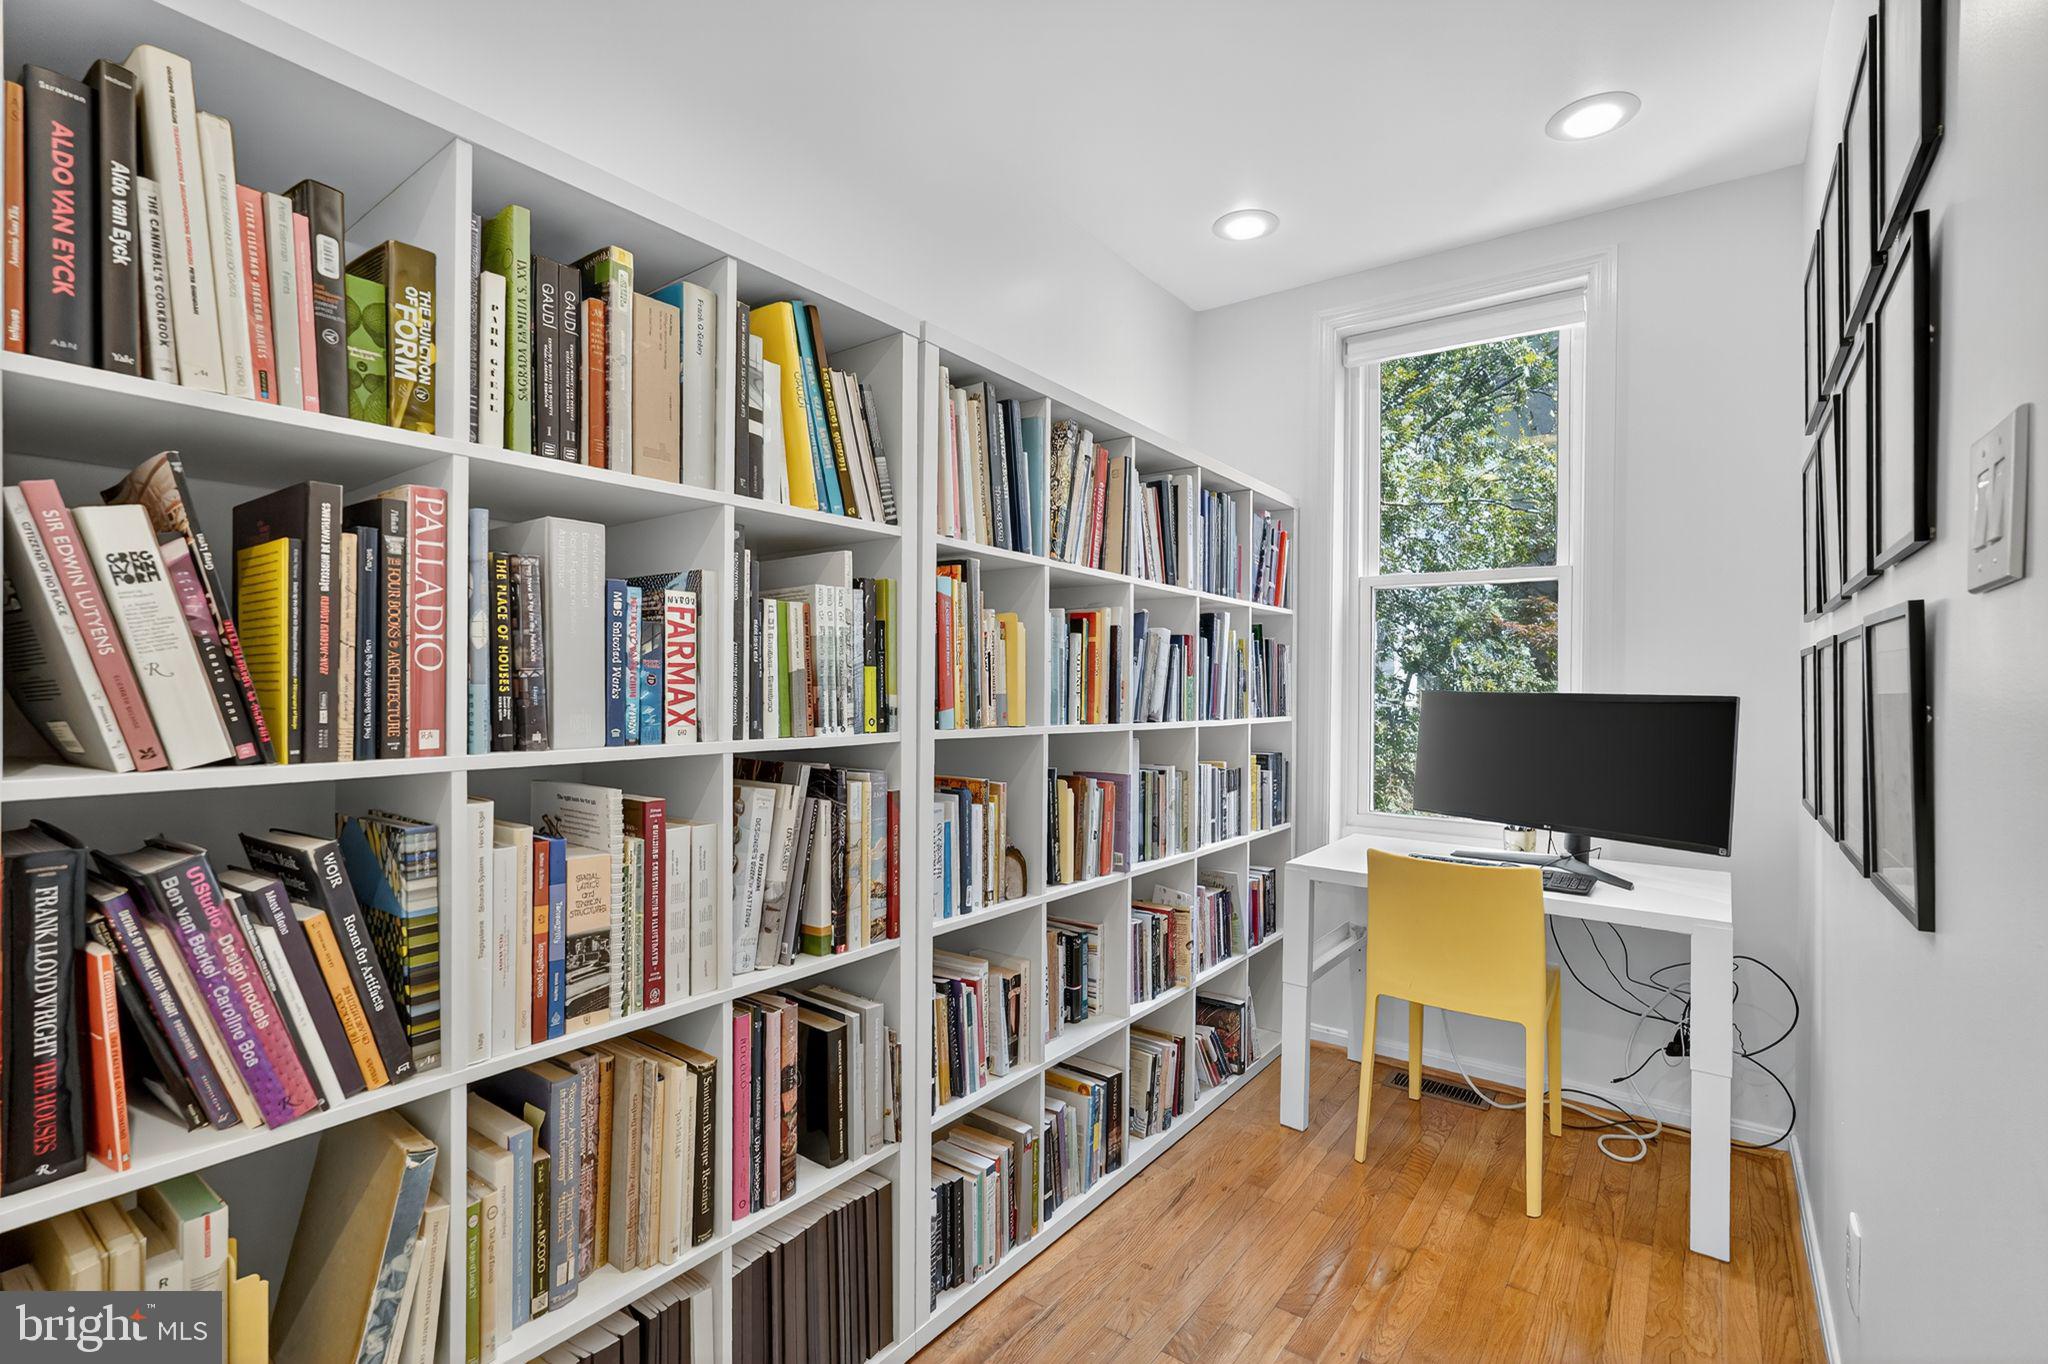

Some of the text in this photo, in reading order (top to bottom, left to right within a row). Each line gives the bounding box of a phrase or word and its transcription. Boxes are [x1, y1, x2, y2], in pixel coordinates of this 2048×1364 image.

[51, 120, 76, 298] ALDO VAN EYCK
[108, 160, 132, 267] Aldo van Eyck
[147, 195, 169, 348] THE CANNIBAL'S COOKBOOK
[394, 286, 419, 382] OF FORM
[418, 290, 432, 386] THE FUNCTION
[517, 347, 529, 402] SAGRADA
[42, 509, 116, 656] SIR EDWIN LUTYENS
[386, 600, 402, 640] BOOKS
[387, 567, 402, 599] FOUR
[414, 495, 446, 672] PALLADIO
[495, 558, 510, 693] THE PLACE OF HOUSES
[386, 650, 402, 738] ARCHITECTURE
[666, 606, 696, 727] FARMAX
[118, 909, 179, 1018] DETAILS OF FRANK LLOYD WRIGHT
[161, 875, 259, 1068] Ben van Berkel Caroline Bos
[186, 865, 222, 929] UNStudio
[218, 932, 248, 982] Design
[240, 982, 271, 1030] models
[323, 852, 385, 1013] WOJR Room for Artifacts
[32, 885, 59, 1156] FRANK LLOYD WRIGHT THE HOUSES
[701, 1075, 713, 1123] Southern
